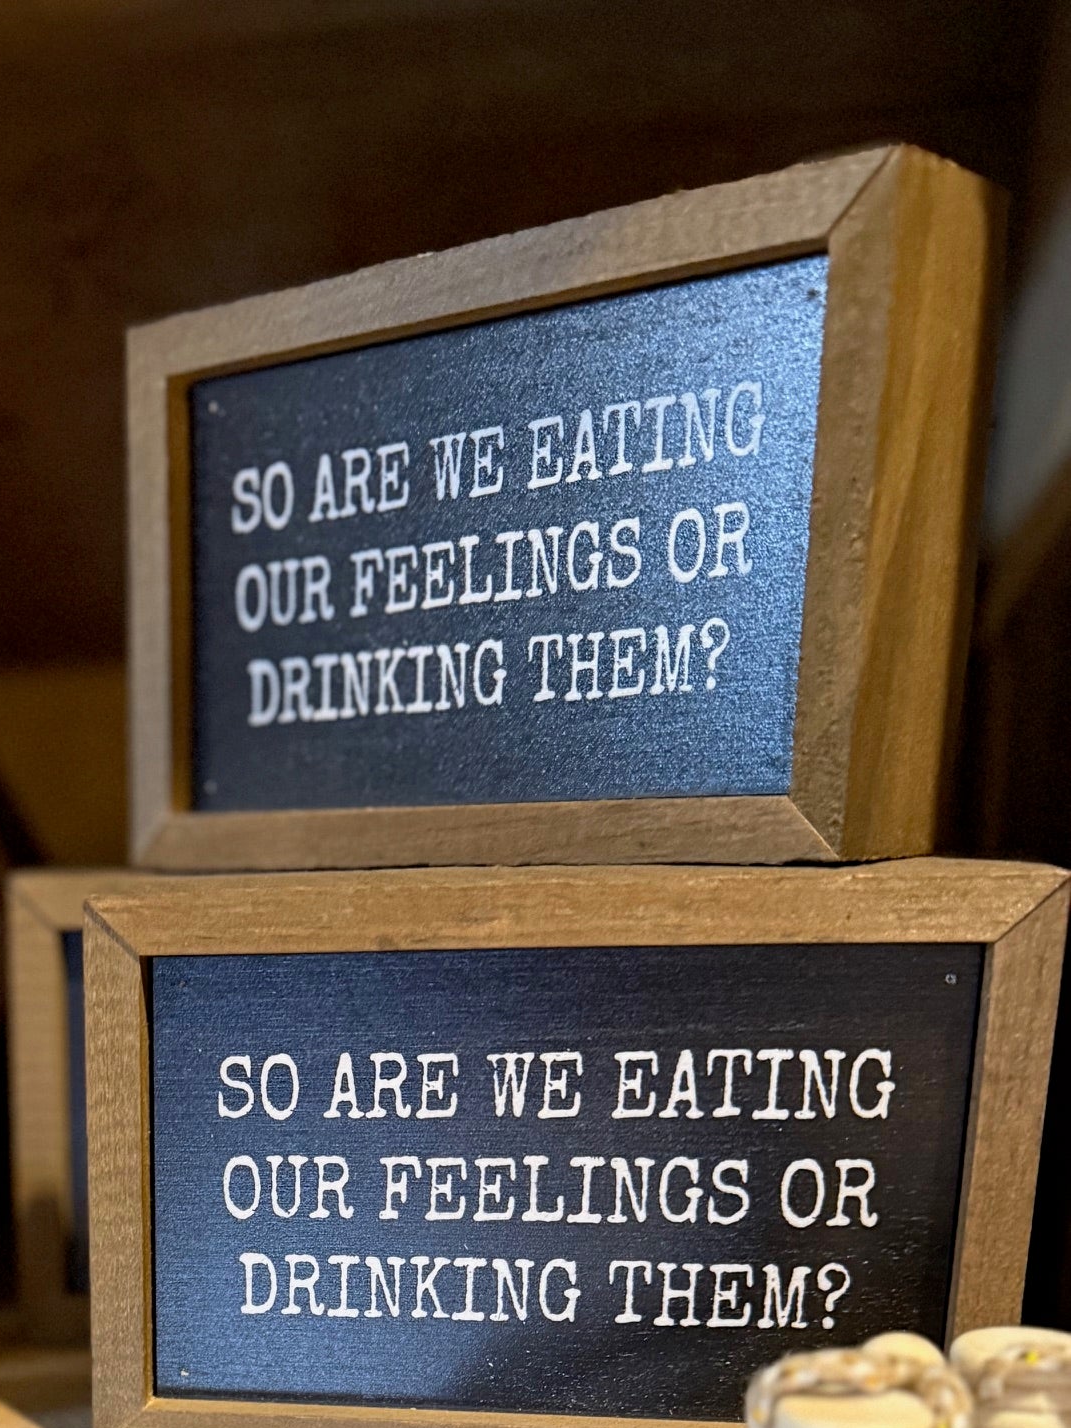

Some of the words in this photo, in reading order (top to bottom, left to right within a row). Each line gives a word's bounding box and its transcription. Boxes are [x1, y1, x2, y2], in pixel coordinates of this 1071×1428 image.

[233, 462, 293, 532] SO
[310, 442, 409, 521] ARE
[430, 426, 504, 500] WE
[528, 380, 766, 489] EATING
[237, 557, 334, 630] OUR
[352, 517, 642, 616] FEELINGS
[666, 500, 752, 582] OR
[250, 639, 507, 724] DRINKING
[528, 618, 730, 701] THEM?
[218, 1053, 299, 1120] SO
[324, 1052, 458, 1119] ARE
[487, 1052, 583, 1119] WE
[612, 1049, 895, 1119] EATING
[223, 1155, 354, 1219] OUR
[379, 1156, 749, 1224] FEELINGS
[781, 1159, 877, 1227] OR
[239, 1253, 580, 1322] DRINKING
[609, 1260, 850, 1329] THEM?
